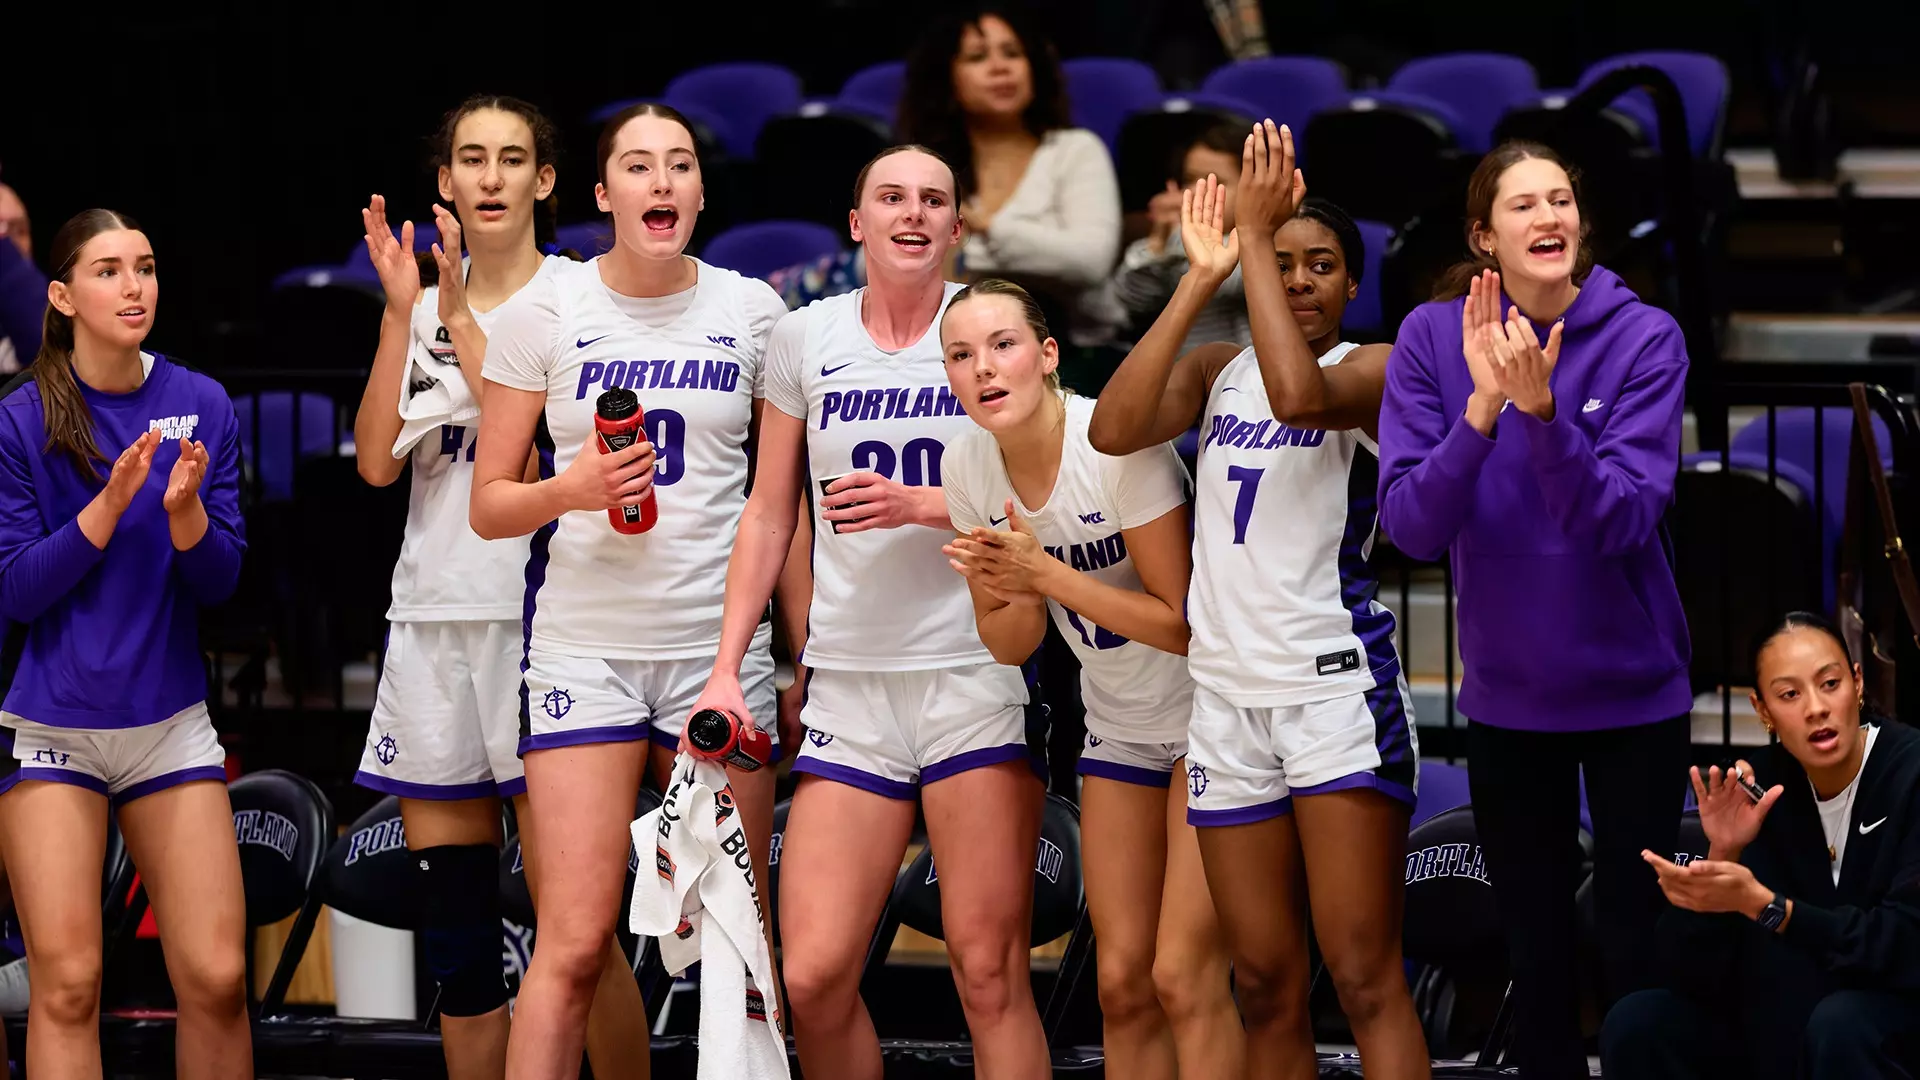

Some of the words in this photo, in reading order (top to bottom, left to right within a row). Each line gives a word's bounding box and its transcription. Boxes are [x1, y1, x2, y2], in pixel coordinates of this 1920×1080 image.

[575, 359, 741, 400] PORTLAND
[149, 414, 199, 433] PORTLAND
[160, 426, 193, 443] PILOTS
[643, 408, 686, 486] 9
[1227, 465, 1266, 544] 7
[1345, 655, 1354, 665] M
